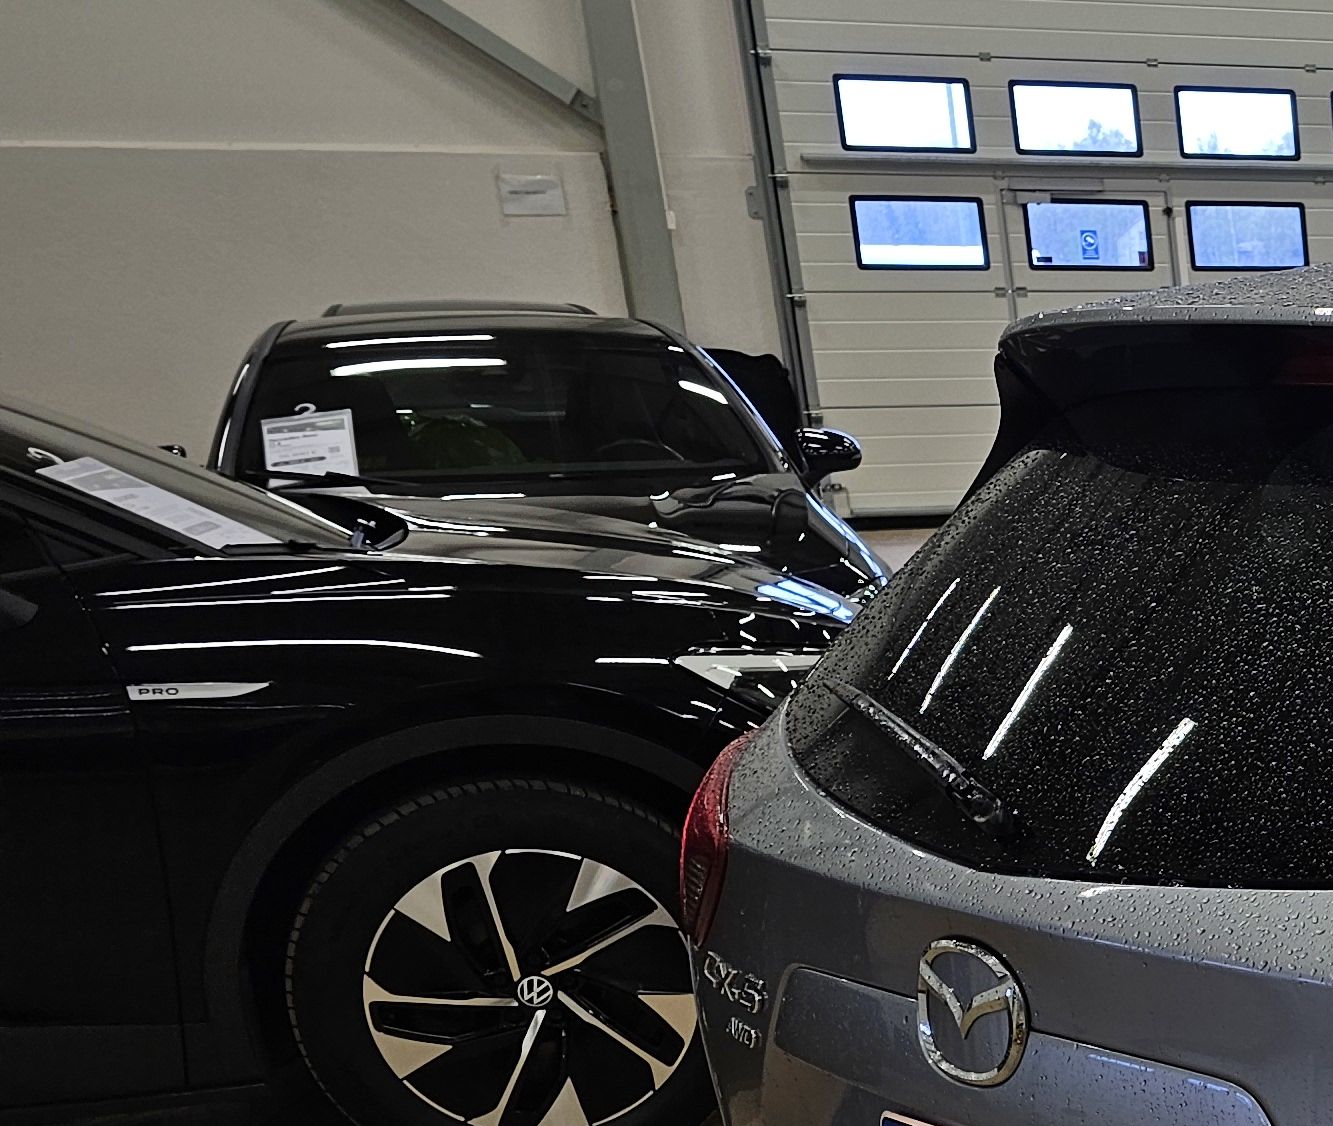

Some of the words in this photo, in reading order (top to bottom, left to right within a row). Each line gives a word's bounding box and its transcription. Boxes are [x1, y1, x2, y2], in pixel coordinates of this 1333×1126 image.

[138, 687, 179, 696] PRO
[704, 950, 768, 1013] CX-5
[726, 1017, 761, 1048] AWD
